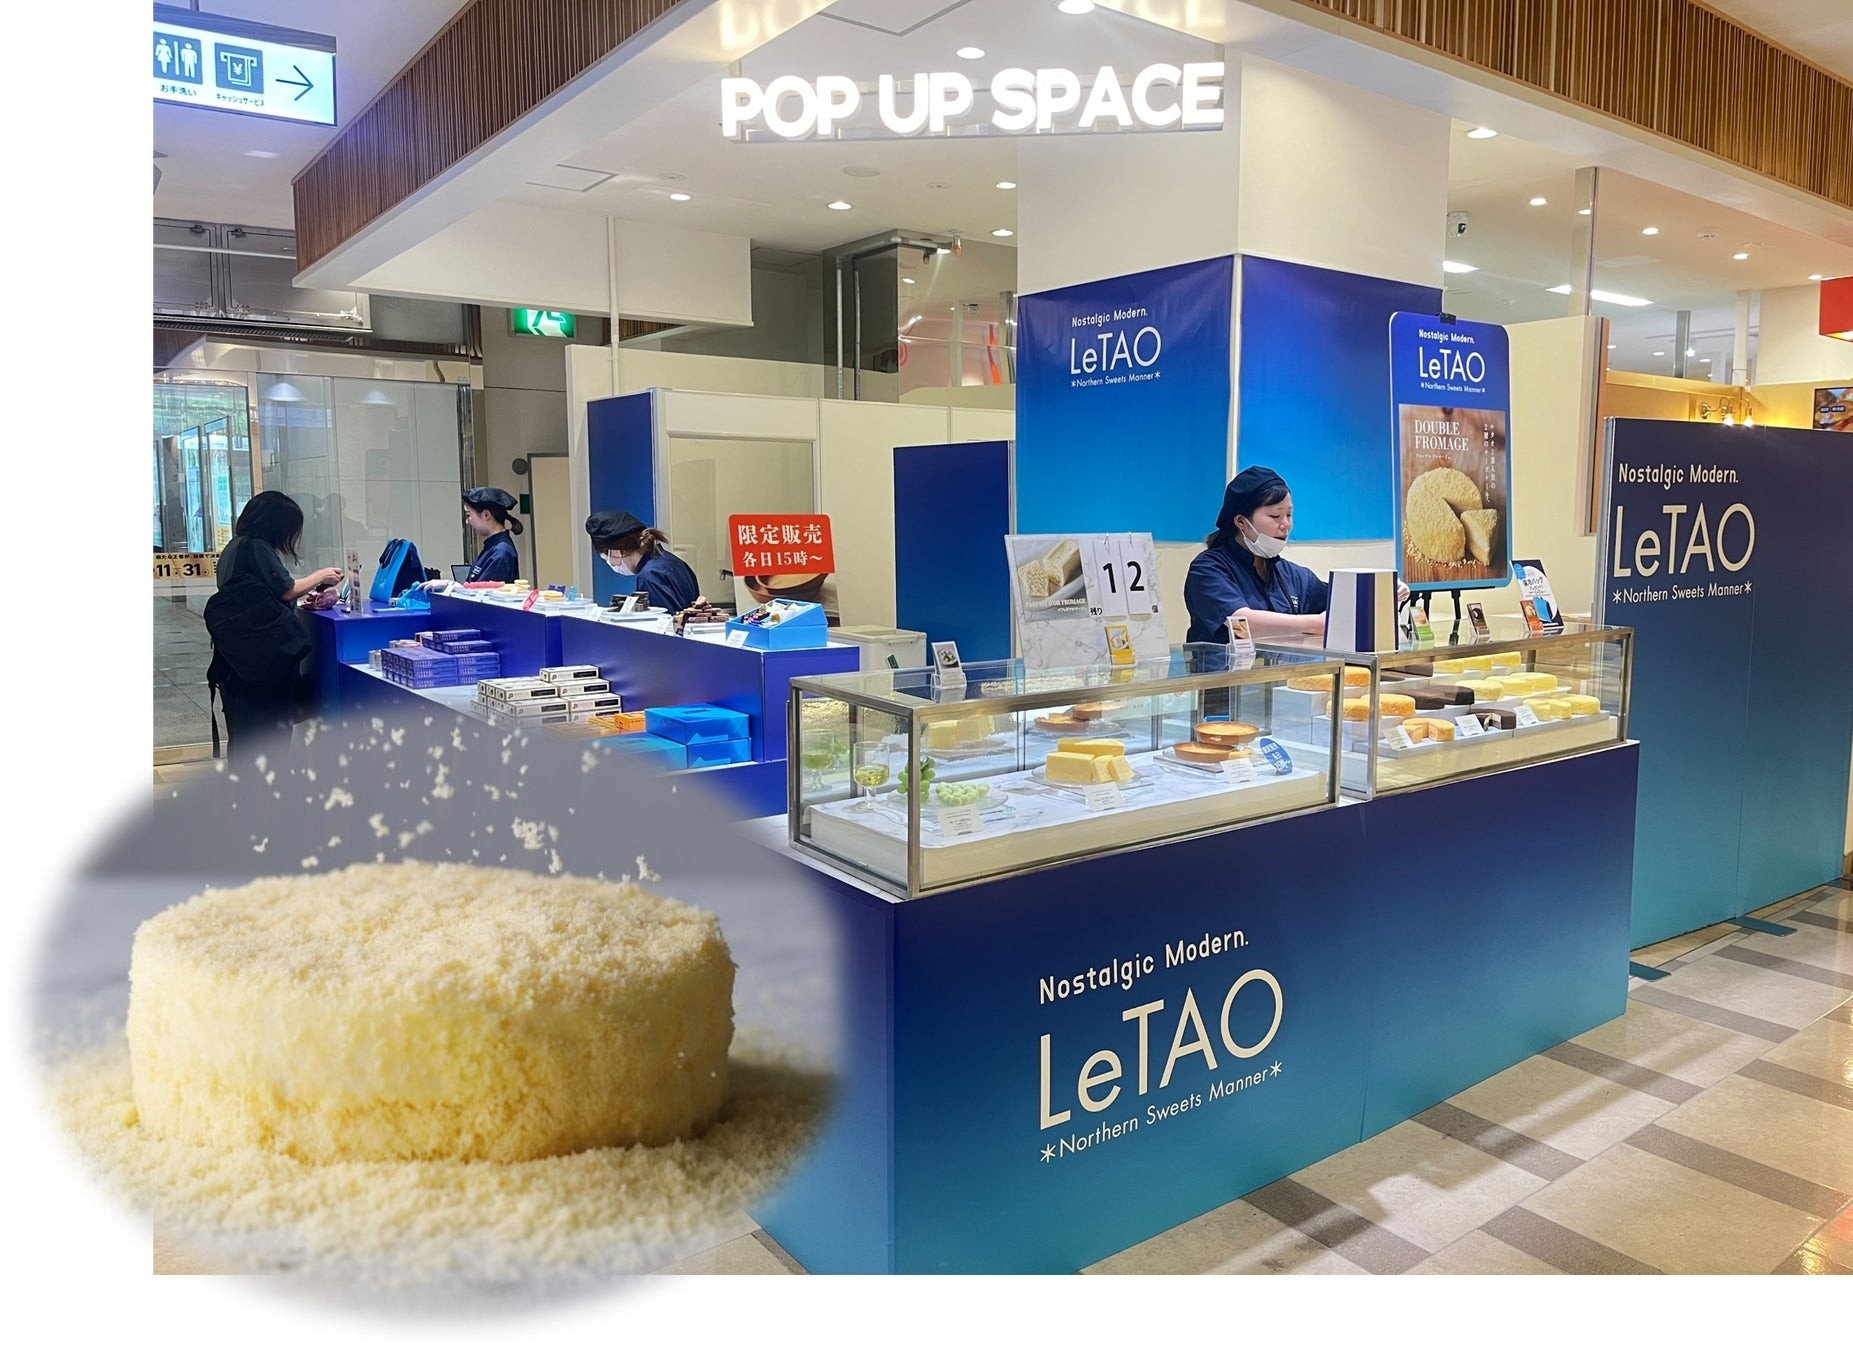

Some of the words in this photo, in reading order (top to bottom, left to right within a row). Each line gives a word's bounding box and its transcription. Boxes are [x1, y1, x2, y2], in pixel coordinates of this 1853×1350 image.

[160, 84, 197, 96] お手洗い
[216, 92, 265, 107] キャッシュサービス
[721, 75, 861, 140] POP
[879, 72, 974, 136] UP
[991, 61, 1225, 132] SPACE
[1072, 312, 1110, 327] Nostalgic
[1114, 308, 1148, 321] Modern.
[1419, 329, 1449, 343] Nostalgic
[1071, 326, 1161, 375] LeTAO
[1419, 346, 1485, 383] LeTAO
[1105, 374, 1126, 385] Sweets
[1414, 419, 1460, 435] DOUBLE
[1415, 435, 1469, 451] FROMAGE
[1618, 463, 1684, 491] Nostalgic
[1689, 464, 1739, 483] Modern.
[737, 524, 823, 545] 限定販売
[1613, 502, 1756, 578] LeTAO
[1671, 584, 1704, 600] Sweets
[1039, 953, 1154, 1004] Nostalgic
[1165, 929, 1249, 968] Modern.
[1040, 969, 1284, 1130] LeTAO
[1146, 1093, 1202, 1125] Sweets
